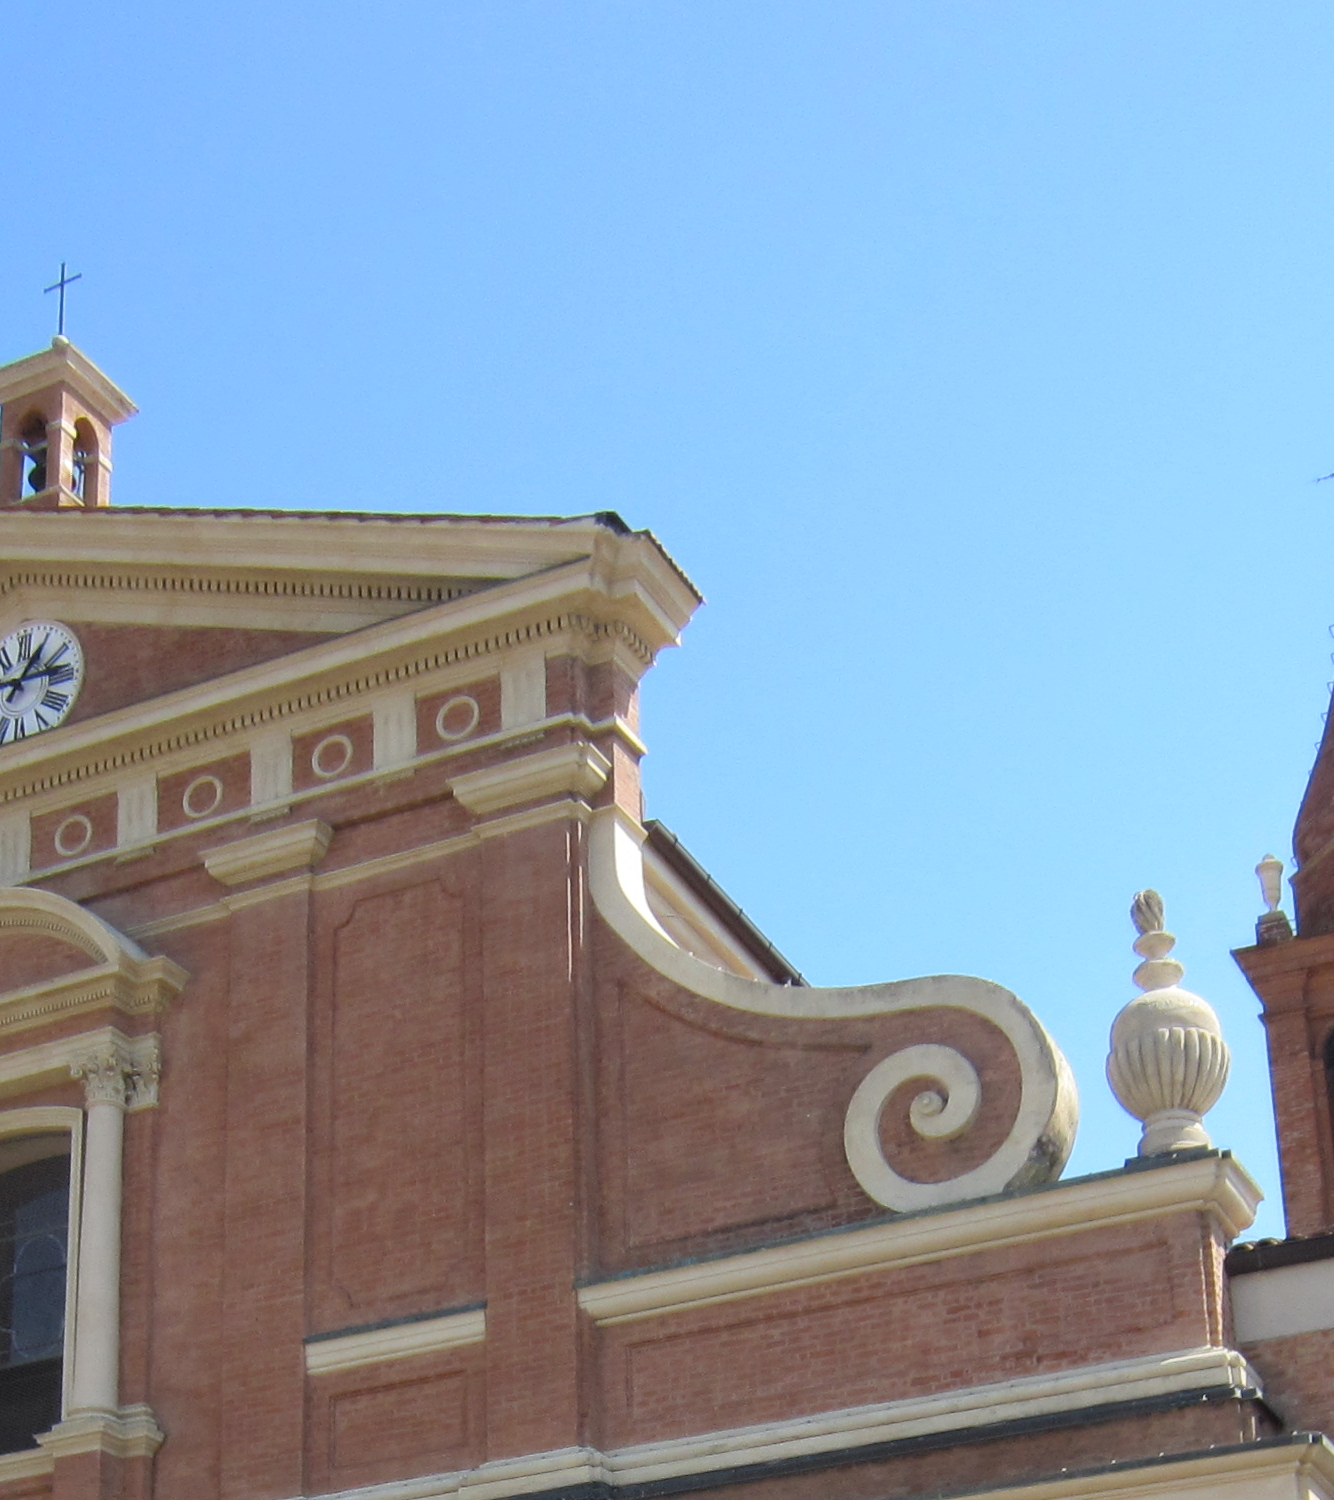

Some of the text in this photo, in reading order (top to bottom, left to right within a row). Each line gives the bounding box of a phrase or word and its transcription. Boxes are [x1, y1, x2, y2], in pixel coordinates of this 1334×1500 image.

[17, 633, 33, 662] XII
[44, 642, 69, 667] II
[41, 690, 69, 712] IIII
[33, 708, 49, 731] V
